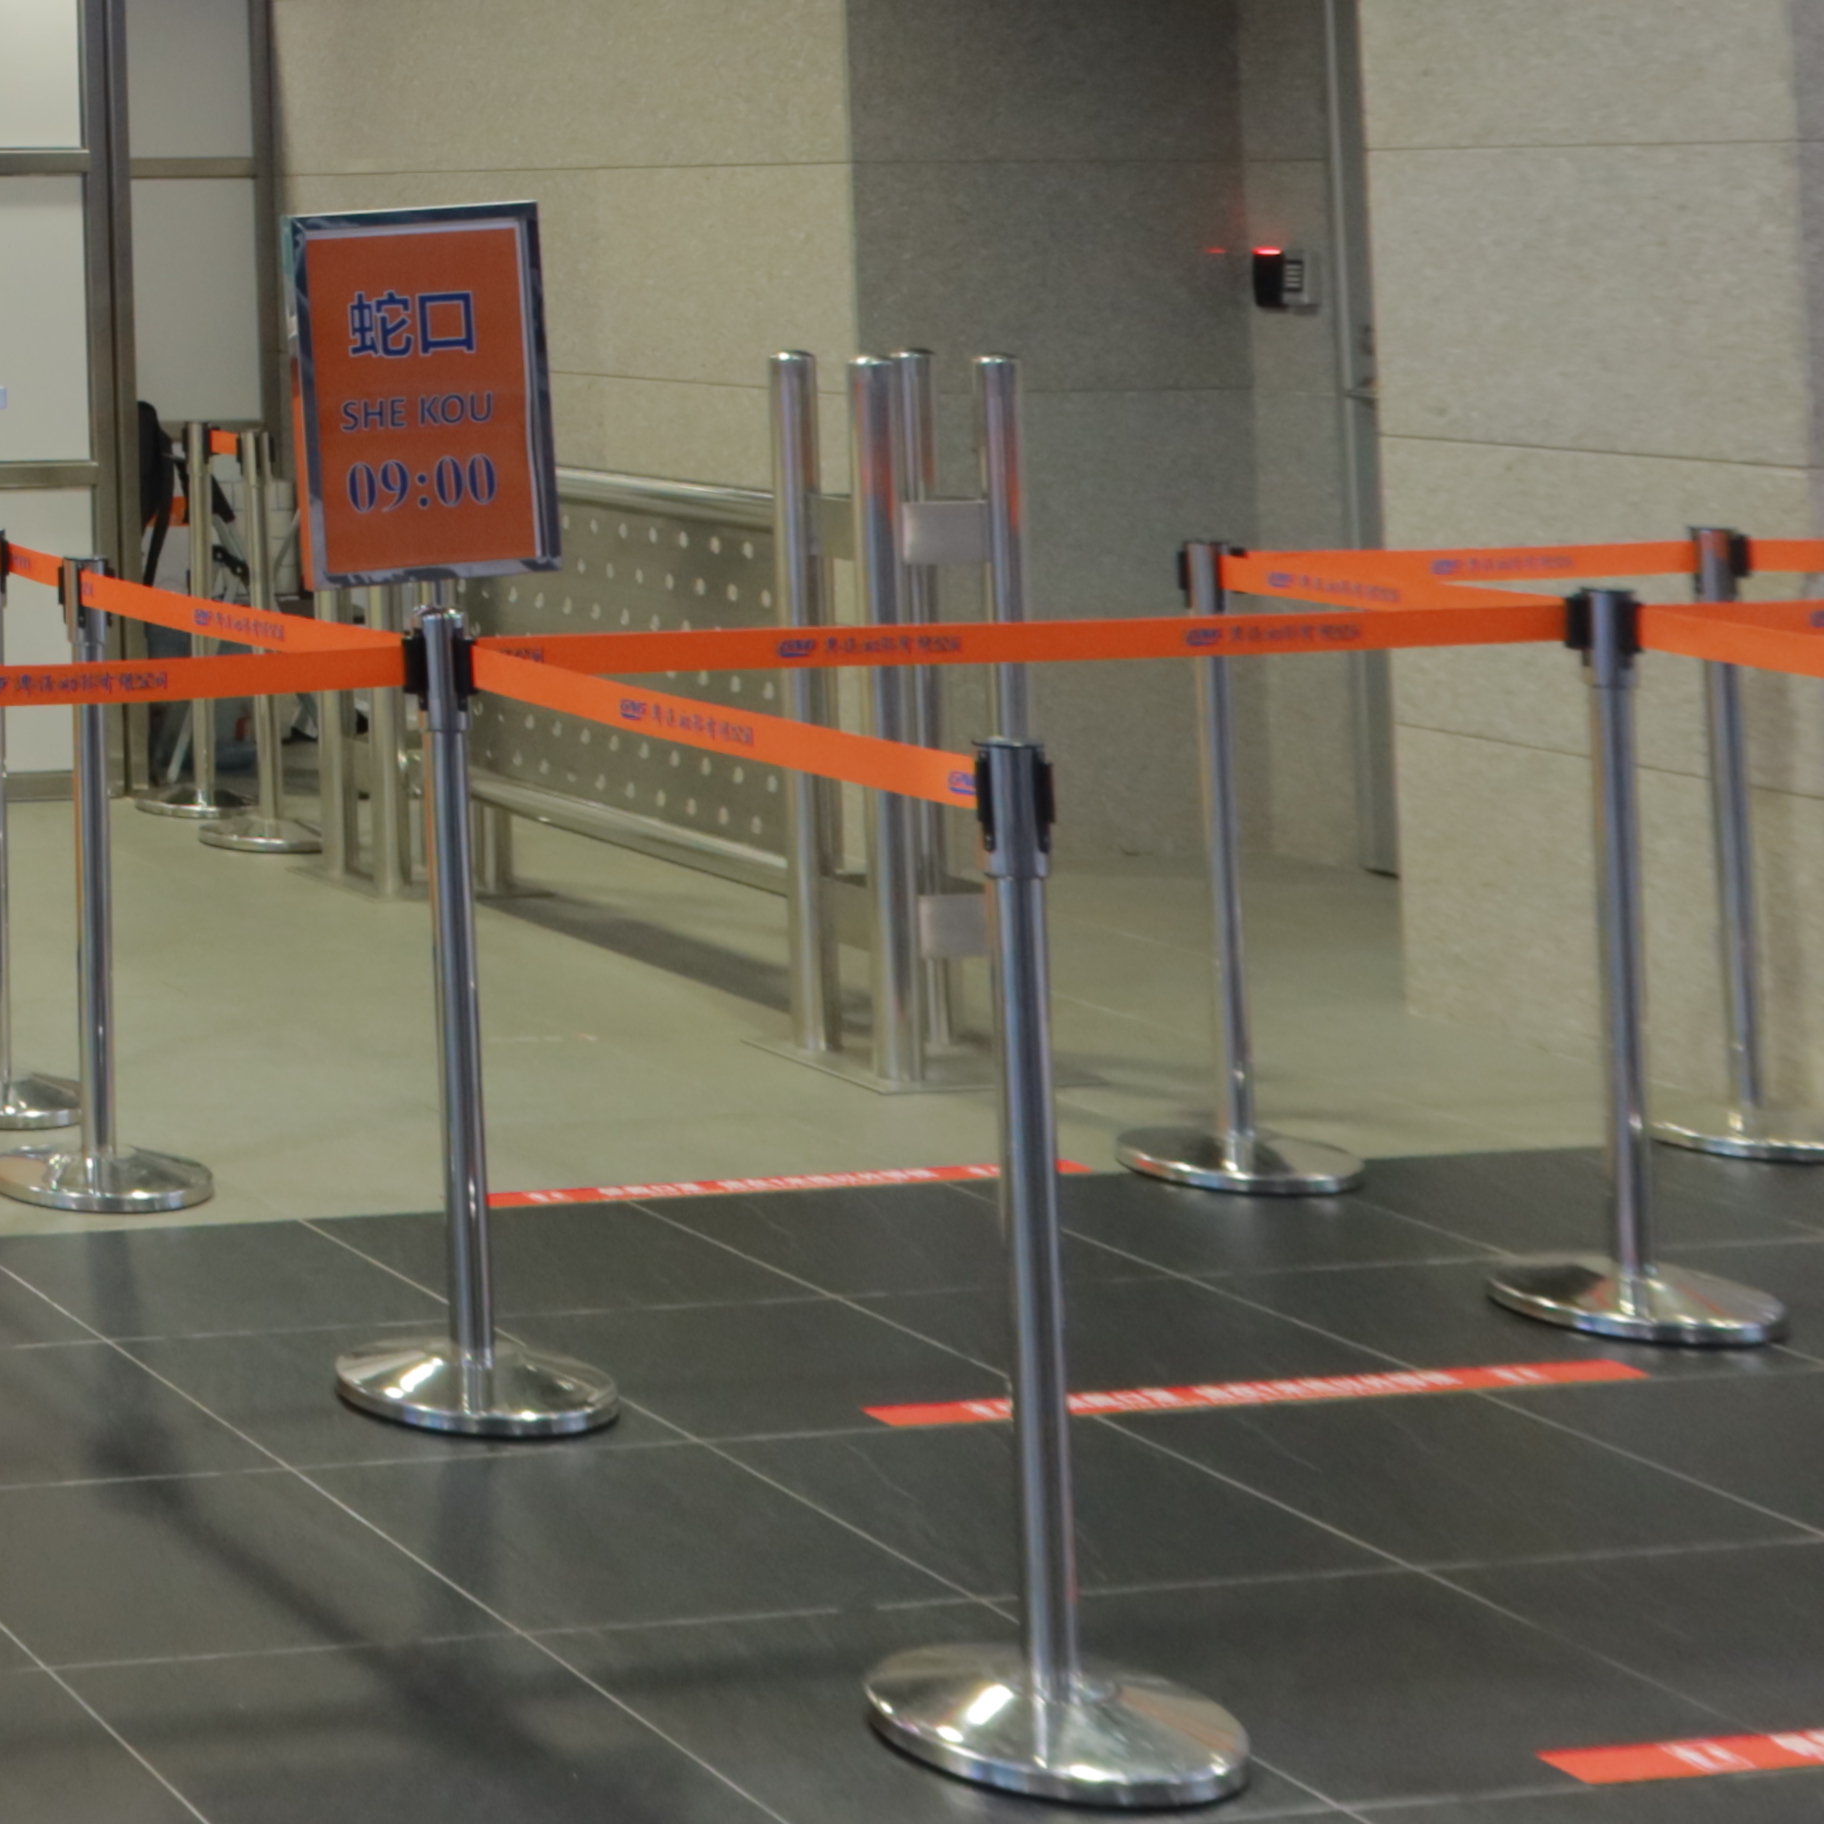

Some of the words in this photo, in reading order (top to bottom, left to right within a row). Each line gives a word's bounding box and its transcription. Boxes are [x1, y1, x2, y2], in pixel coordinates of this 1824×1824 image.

[348, 289, 477, 359] 蛇口
[340, 398, 407, 432] SHE
[419, 392, 494, 426] KOU
[347, 453, 497, 514] 09:00
